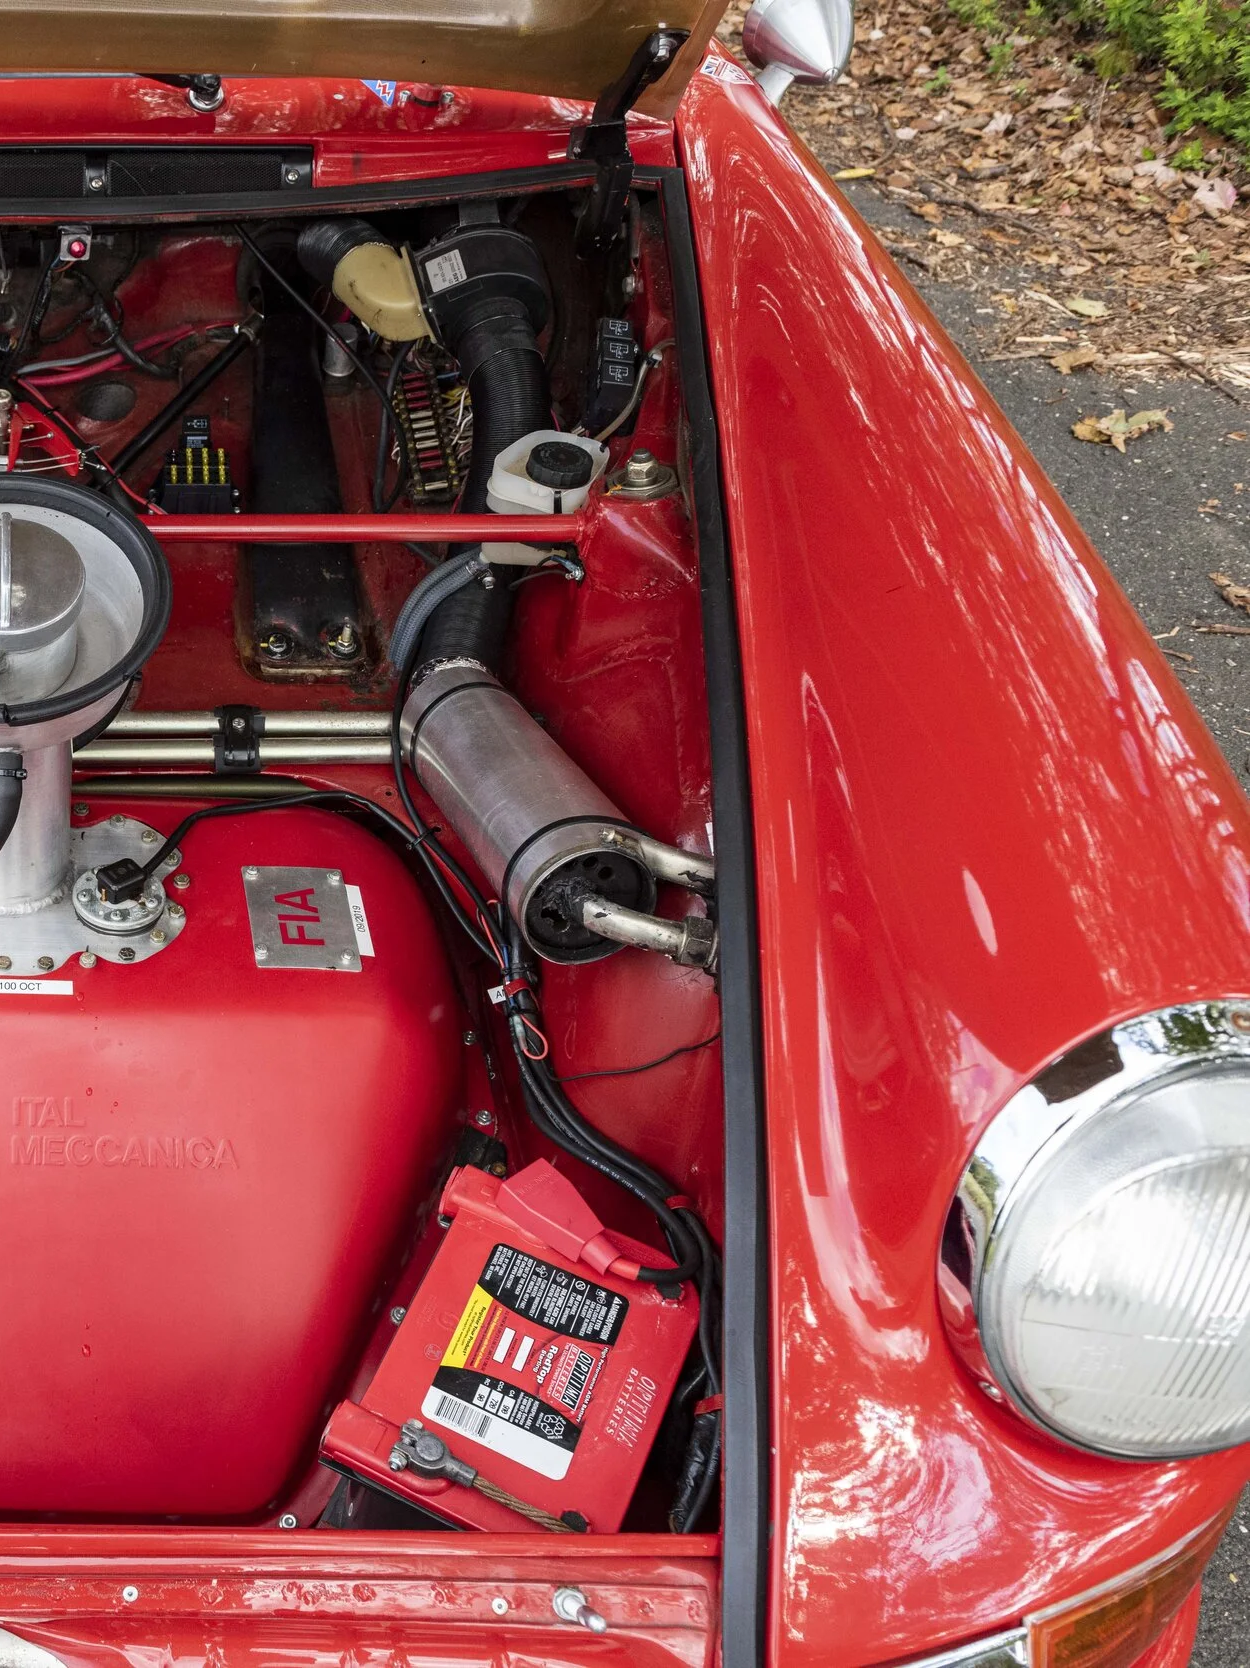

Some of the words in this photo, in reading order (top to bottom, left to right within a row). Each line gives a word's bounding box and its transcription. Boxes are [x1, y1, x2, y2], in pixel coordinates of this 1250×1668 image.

[275, 888, 325, 945] FIA
[352, 905, 366, 932] 09/2019
[0, 982, 17, 990] 100
[20, 983, 42, 991] OCT
[12, 1096, 86, 1127] ITAL
[10, 1134, 239, 1170] MECCANICA
[473, 1305, 487, 1326] Register
[469, 1324, 478, 1337] Your
[531, 1348, 547, 1373] Starting
[534, 1343, 559, 1385] RedTop
[599, 1345, 609, 1359] High
[483, 1377, 491, 1386] RC
[552, 1345, 579, 1398] BATTERIES
[560, 1351, 594, 1406] OPTIMA
[587, 1358, 604, 1390] Performance
[475, 1392, 485, 1402] 90
[495, 1380, 504, 1392] CCA
[507, 1388, 515, 1398] CA
[582, 1389, 592, 1404] AGM
[487, 1397, 499, 1410] 720
[574, 1402, 587, 1423] Battery
[604, 1366, 639, 1436] BATTERIES
[614, 1374, 659, 1448] OPTIMA
[522, 1399, 540, 1430] NONSPILLABLE
